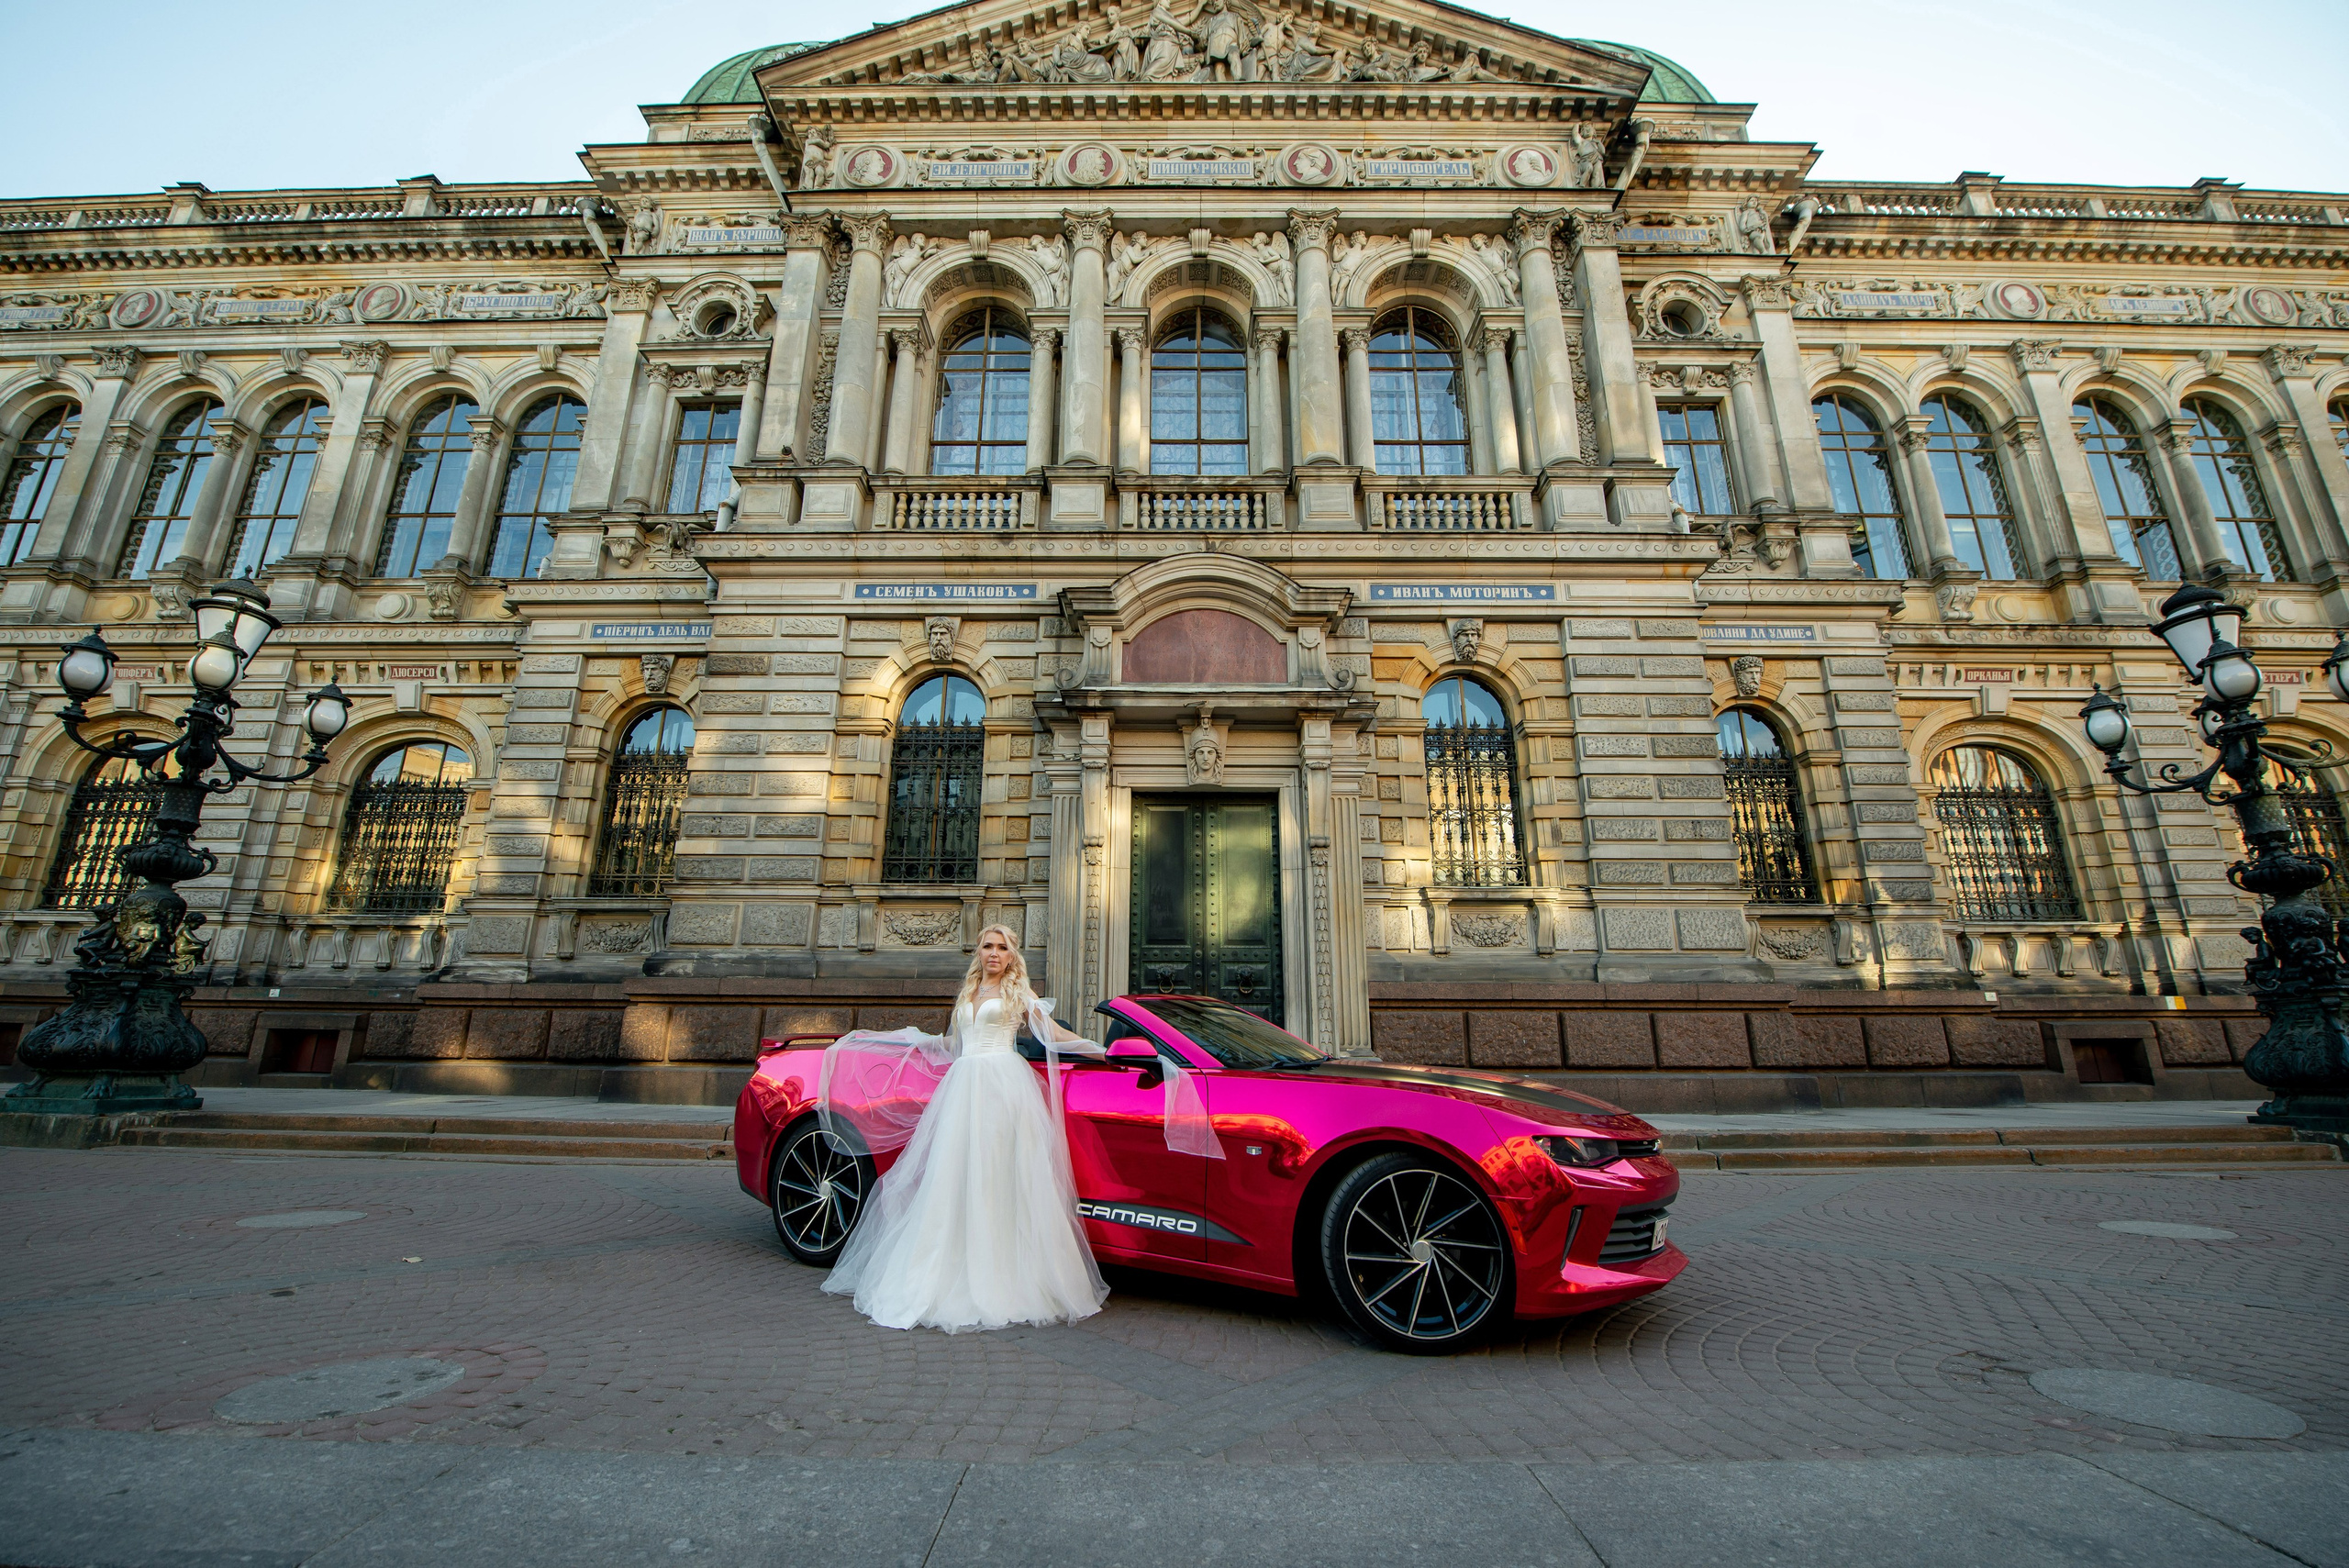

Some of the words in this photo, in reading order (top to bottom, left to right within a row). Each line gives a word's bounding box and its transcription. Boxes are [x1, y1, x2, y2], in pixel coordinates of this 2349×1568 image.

[1371, 163, 1468, 174] ГИРШФОГЕЛЬ
[875, 586, 937, 597] СЕМЕНЪ
[943, 586, 1017, 597] УШАКОВЪ
[1392, 587, 1444, 598] ИВАНЪ
[1450, 587, 1533, 598] МОТОРИНЪ
[657, 626, 687, 637] ДЕЛЬ
[691, 625, 712, 636] ВАГ
[1750, 628, 1766, 639] ДА
[1769, 628, 1805, 639] УДИНЕ
[392, 667, 435, 678] ДЮСЕРСО
[1967, 671, 2010, 681] ОРКАНЬЯ
[2263, 673, 2299, 683] ЕТХЕРЪ
[1076, 1203, 1197, 1233] CAMARO
